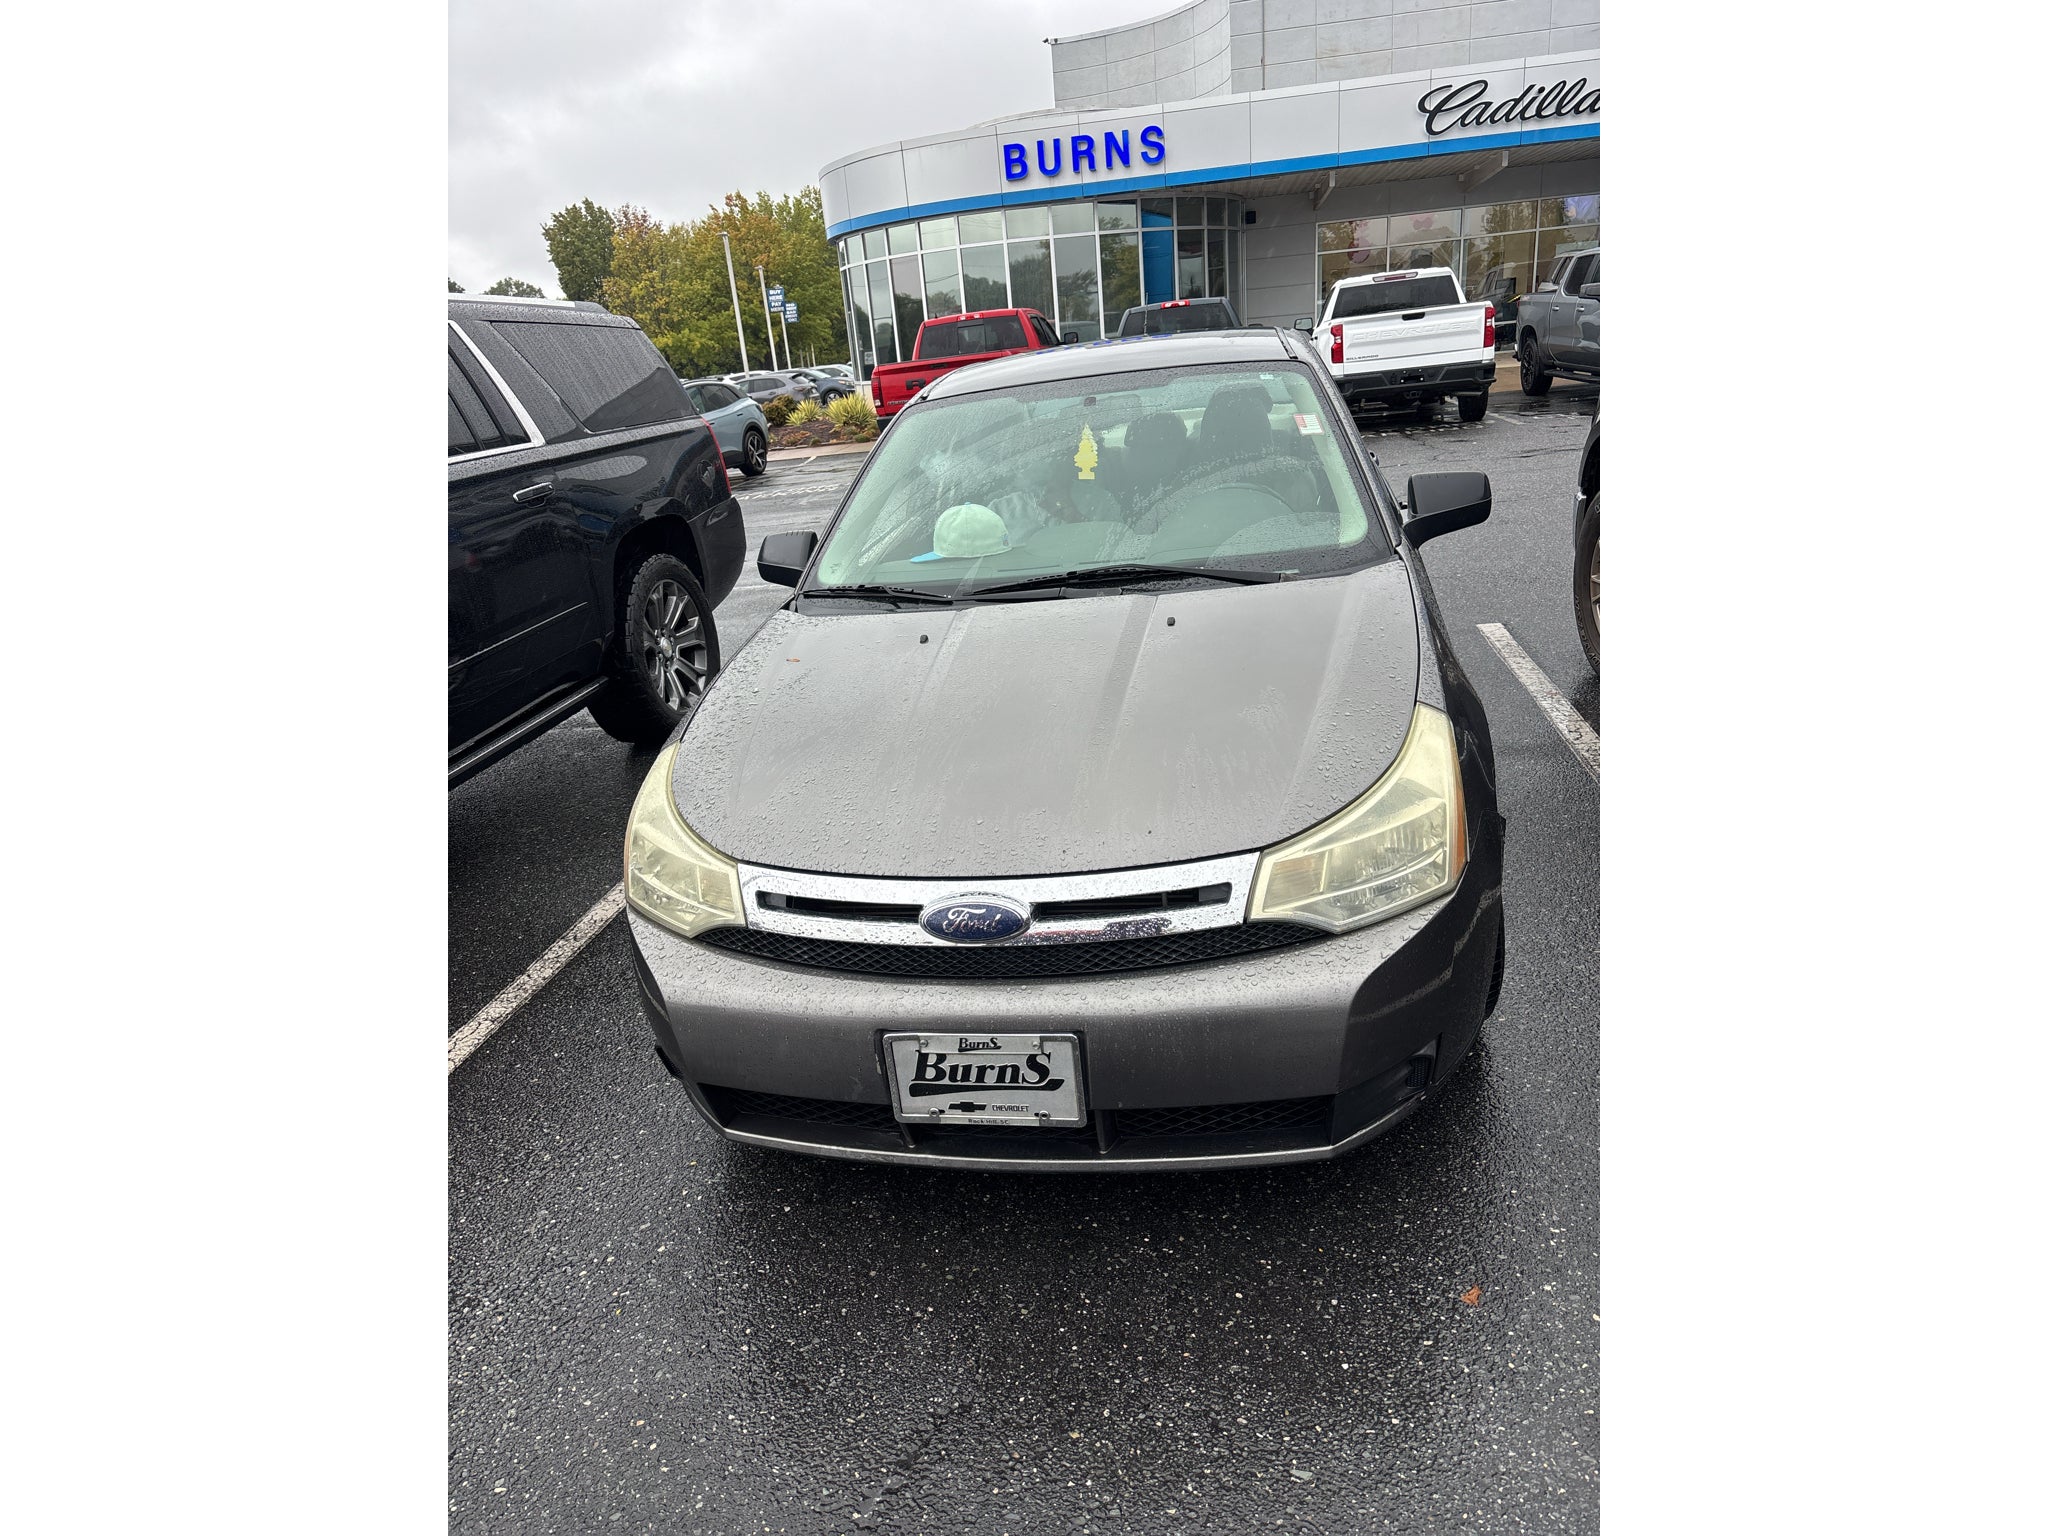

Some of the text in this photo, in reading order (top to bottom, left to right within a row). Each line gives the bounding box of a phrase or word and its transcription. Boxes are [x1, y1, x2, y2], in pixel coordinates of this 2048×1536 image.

[1003, 125, 1166, 182] BURNS
[1351, 319, 1478, 342] CHEVROLET
[942, 907, 1002, 933] Ford
[991, 1104, 1029, 1112] CHEVROLET
